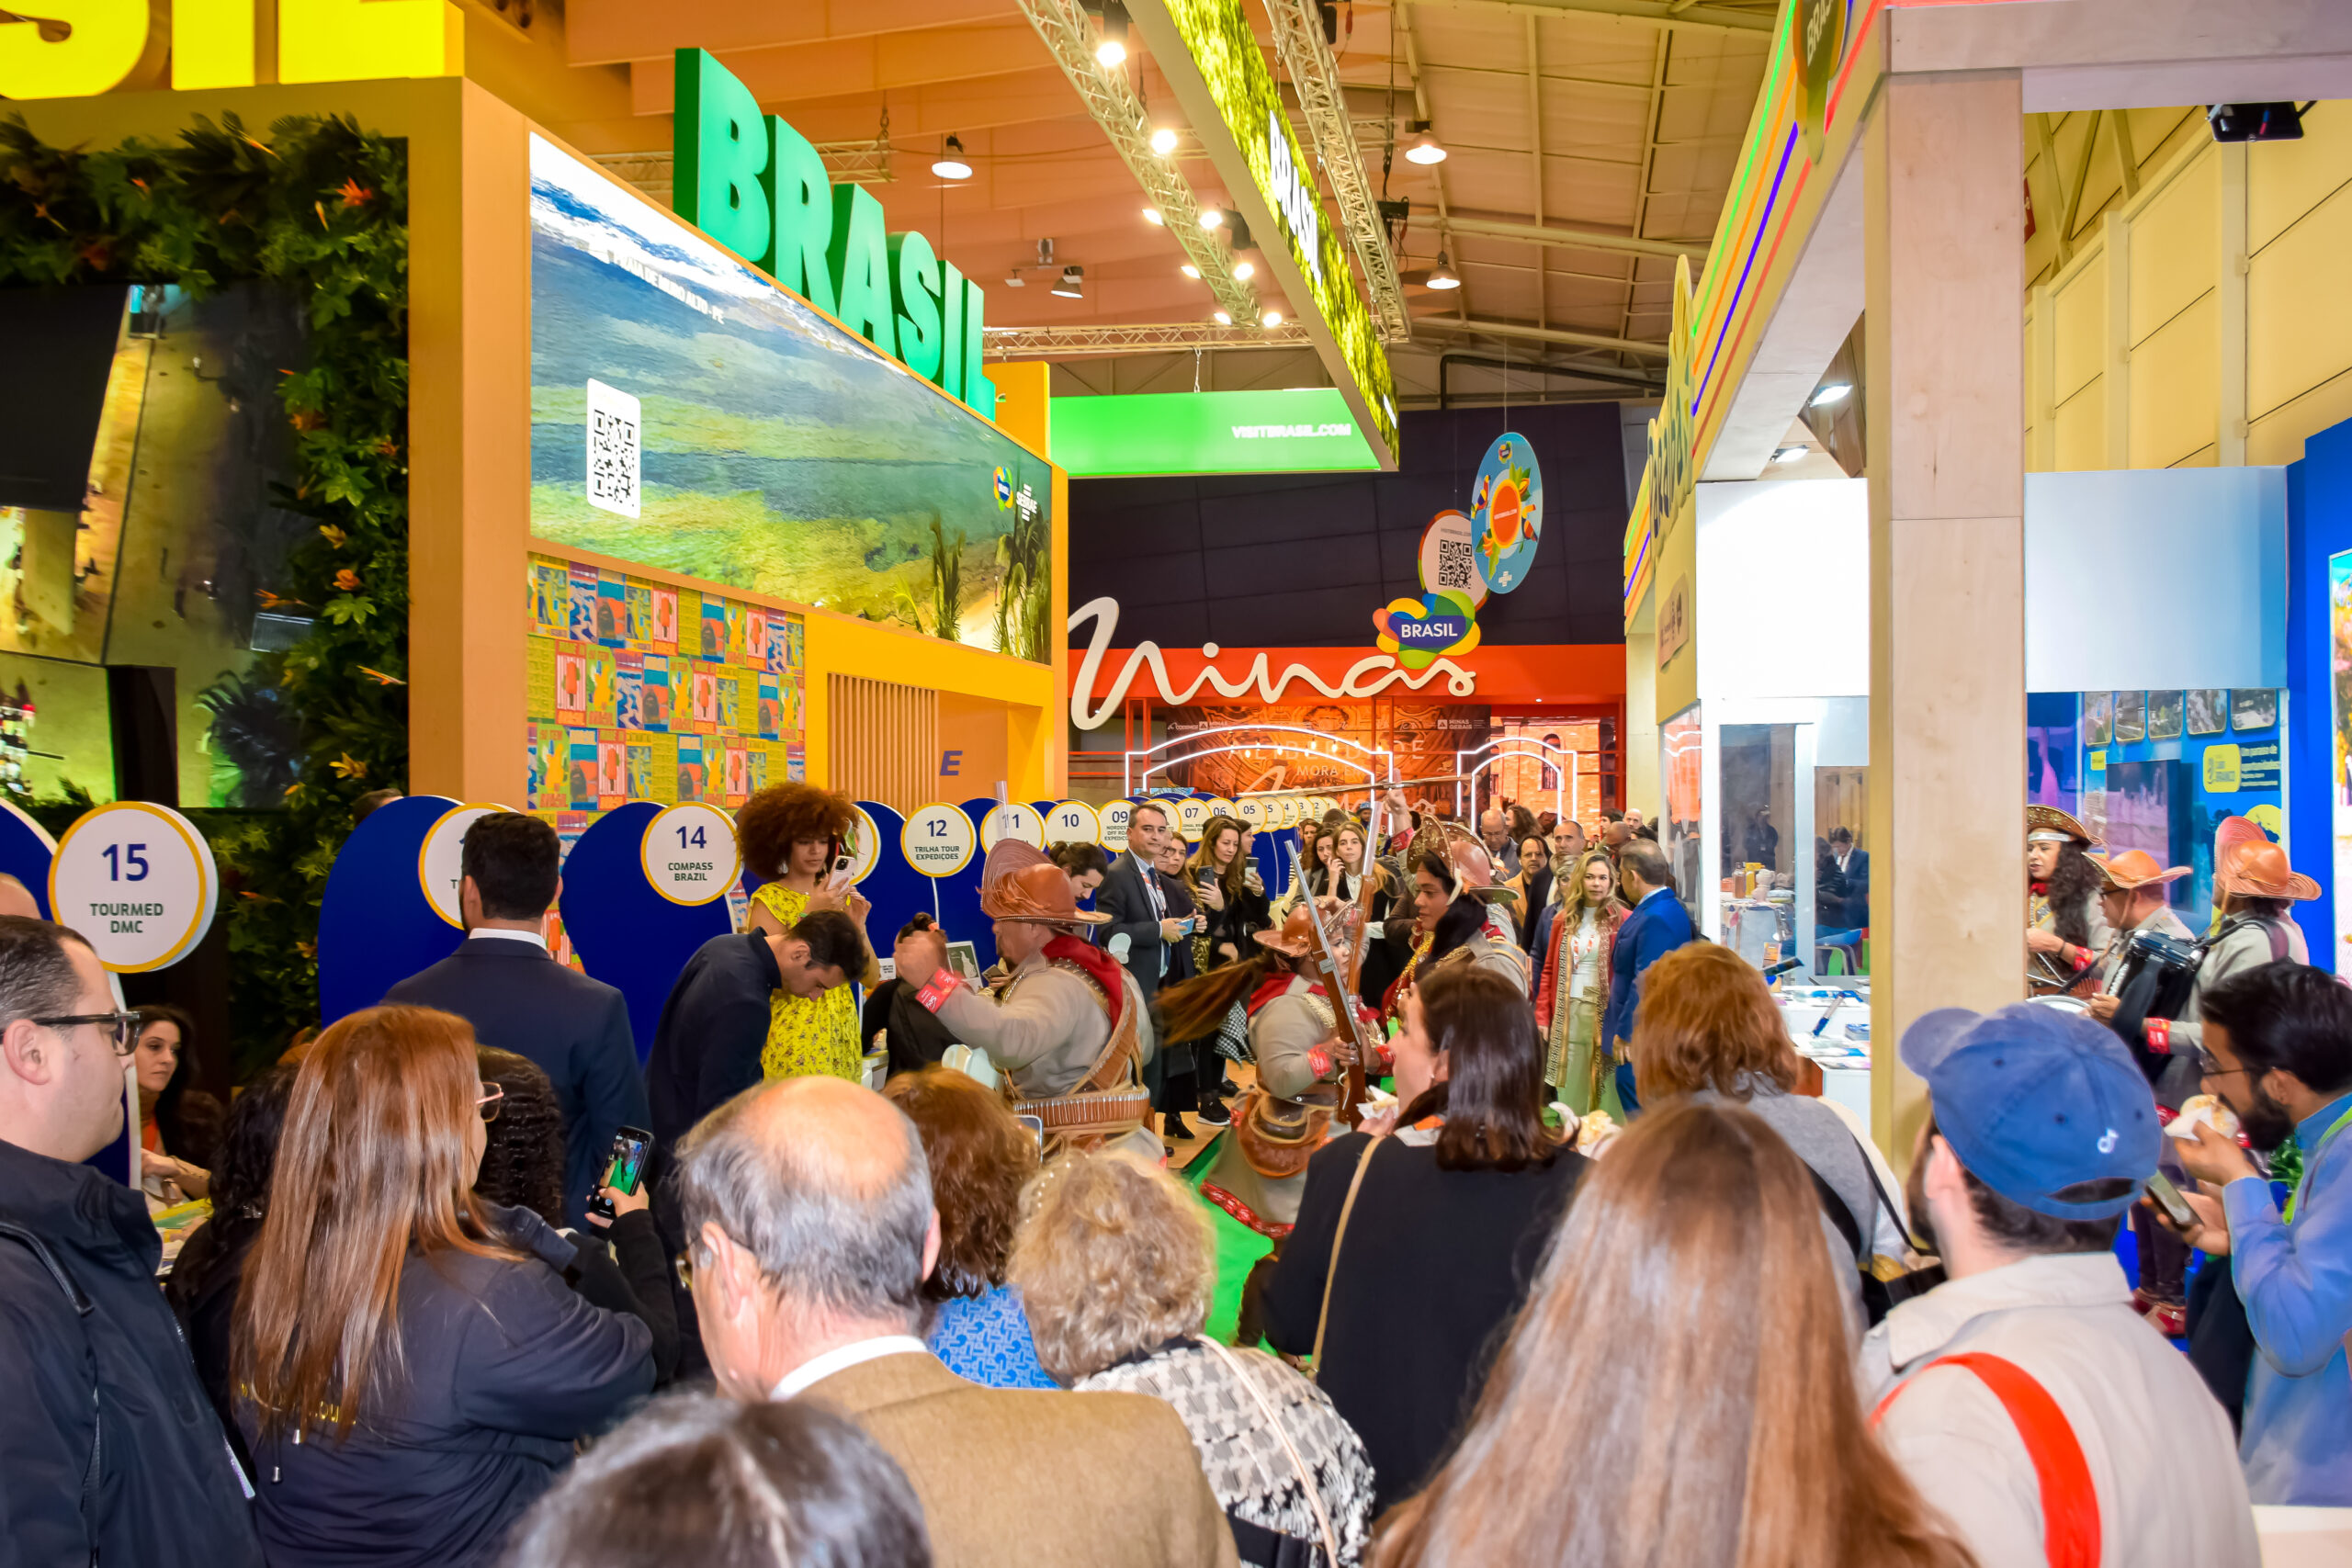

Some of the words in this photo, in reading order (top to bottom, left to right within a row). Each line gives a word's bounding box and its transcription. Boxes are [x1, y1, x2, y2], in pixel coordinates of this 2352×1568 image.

[1270, 109, 1322, 288] BRASIL
[674, 48, 995, 419] BRASIL
[1231, 423, 1351, 438] VISITBRASIL.COM
[1016, 491, 1037, 514] SEBRAE
[1401, 623, 1458, 638] BRASIL
[1069, 597, 1476, 730] Minas
[1296, 765, 1339, 776] MORA
[1112, 811, 1128, 823] 09
[1184, 807, 1199, 818] 07
[1213, 807, 1227, 816] 06
[1243, 805, 1256, 815] 05
[926, 819, 947, 837] 12
[1002, 814, 1020, 829] 11
[1061, 814, 1080, 828] 10
[675, 825, 707, 850] 14
[101, 842, 150, 882] 15
[668, 863, 714, 871] COMPASS
[674, 873, 707, 881] BRAZIL
[89, 903, 164, 917] TOURMED
[109, 920, 143, 933] DMC
